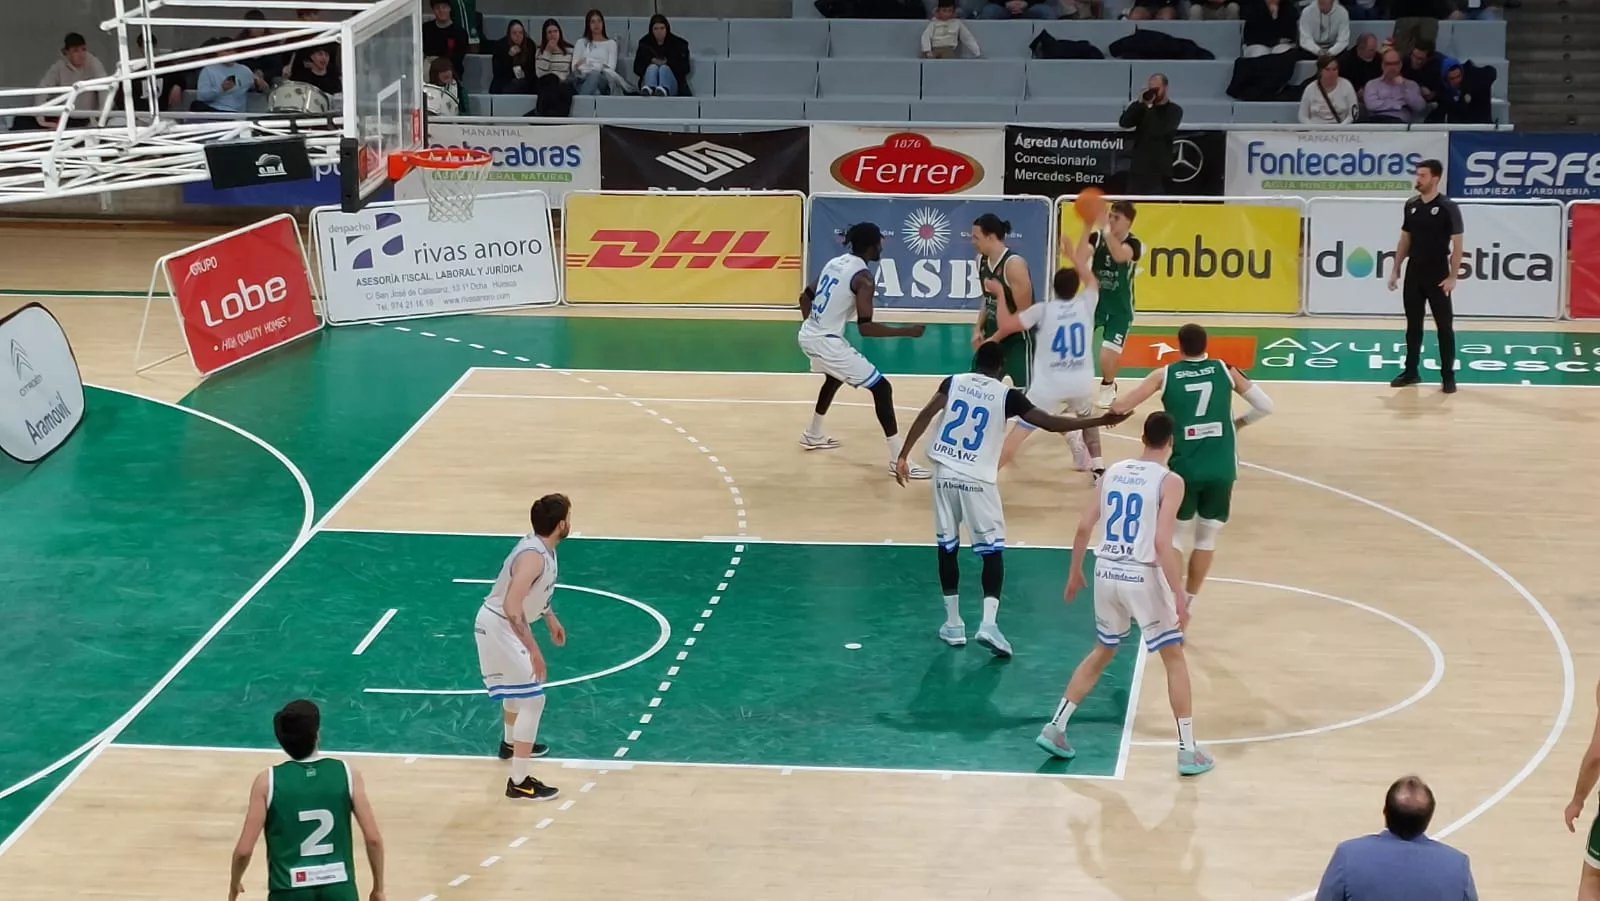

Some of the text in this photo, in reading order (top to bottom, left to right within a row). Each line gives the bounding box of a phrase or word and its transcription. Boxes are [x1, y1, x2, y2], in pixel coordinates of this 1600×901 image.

[461, 128, 522, 137] MANANTIAL
[893, 138, 922, 150] 1876
[1014, 132, 1124, 151] Ágreda Automóvil
[1297, 134, 1362, 143] MANANTIAL
[430, 141, 581, 167] cabras
[1014, 152, 1097, 167] Concesionario
[1247, 141, 1423, 176] Fontecabras
[520, 172, 571, 182] NATURAL
[854, 155, 965, 185] Ferrer
[1014, 169, 1105, 184] Mercedes-Benz
[1263, 181, 1411, 190] AGUA MINERAL NATURAL
[1464, 187, 1590, 196] LIMPIEZA JARDINERIA
[328, 222, 371, 234] despacho
[414, 239, 542, 265] rivas anoro
[587, 229, 781, 269] DHL
[1138, 234, 1272, 280] mbou
[1315, 241, 1554, 281] dostica
[190, 256, 218, 276] GRUPO
[356, 273, 400, 287] ASESORÍA
[436, 268, 476, 280] LABORAL
[478, 267, 485, 276] Y
[485, 263, 524, 275] JURÍDICA
[201, 276, 287, 327] Lobe
[237, 325, 262, 346] QUALITY
[264, 316, 288, 334] HOMES
[1051, 322, 1085, 359] 40
[1261, 352, 1600, 373] de Huesc
[1184, 381, 1213, 417] 7
[25, 390, 71, 446] Aramóvil
[940, 399, 990, 451] 23
[1106, 491, 1143, 543] 28
[298, 809, 334, 857] 2
